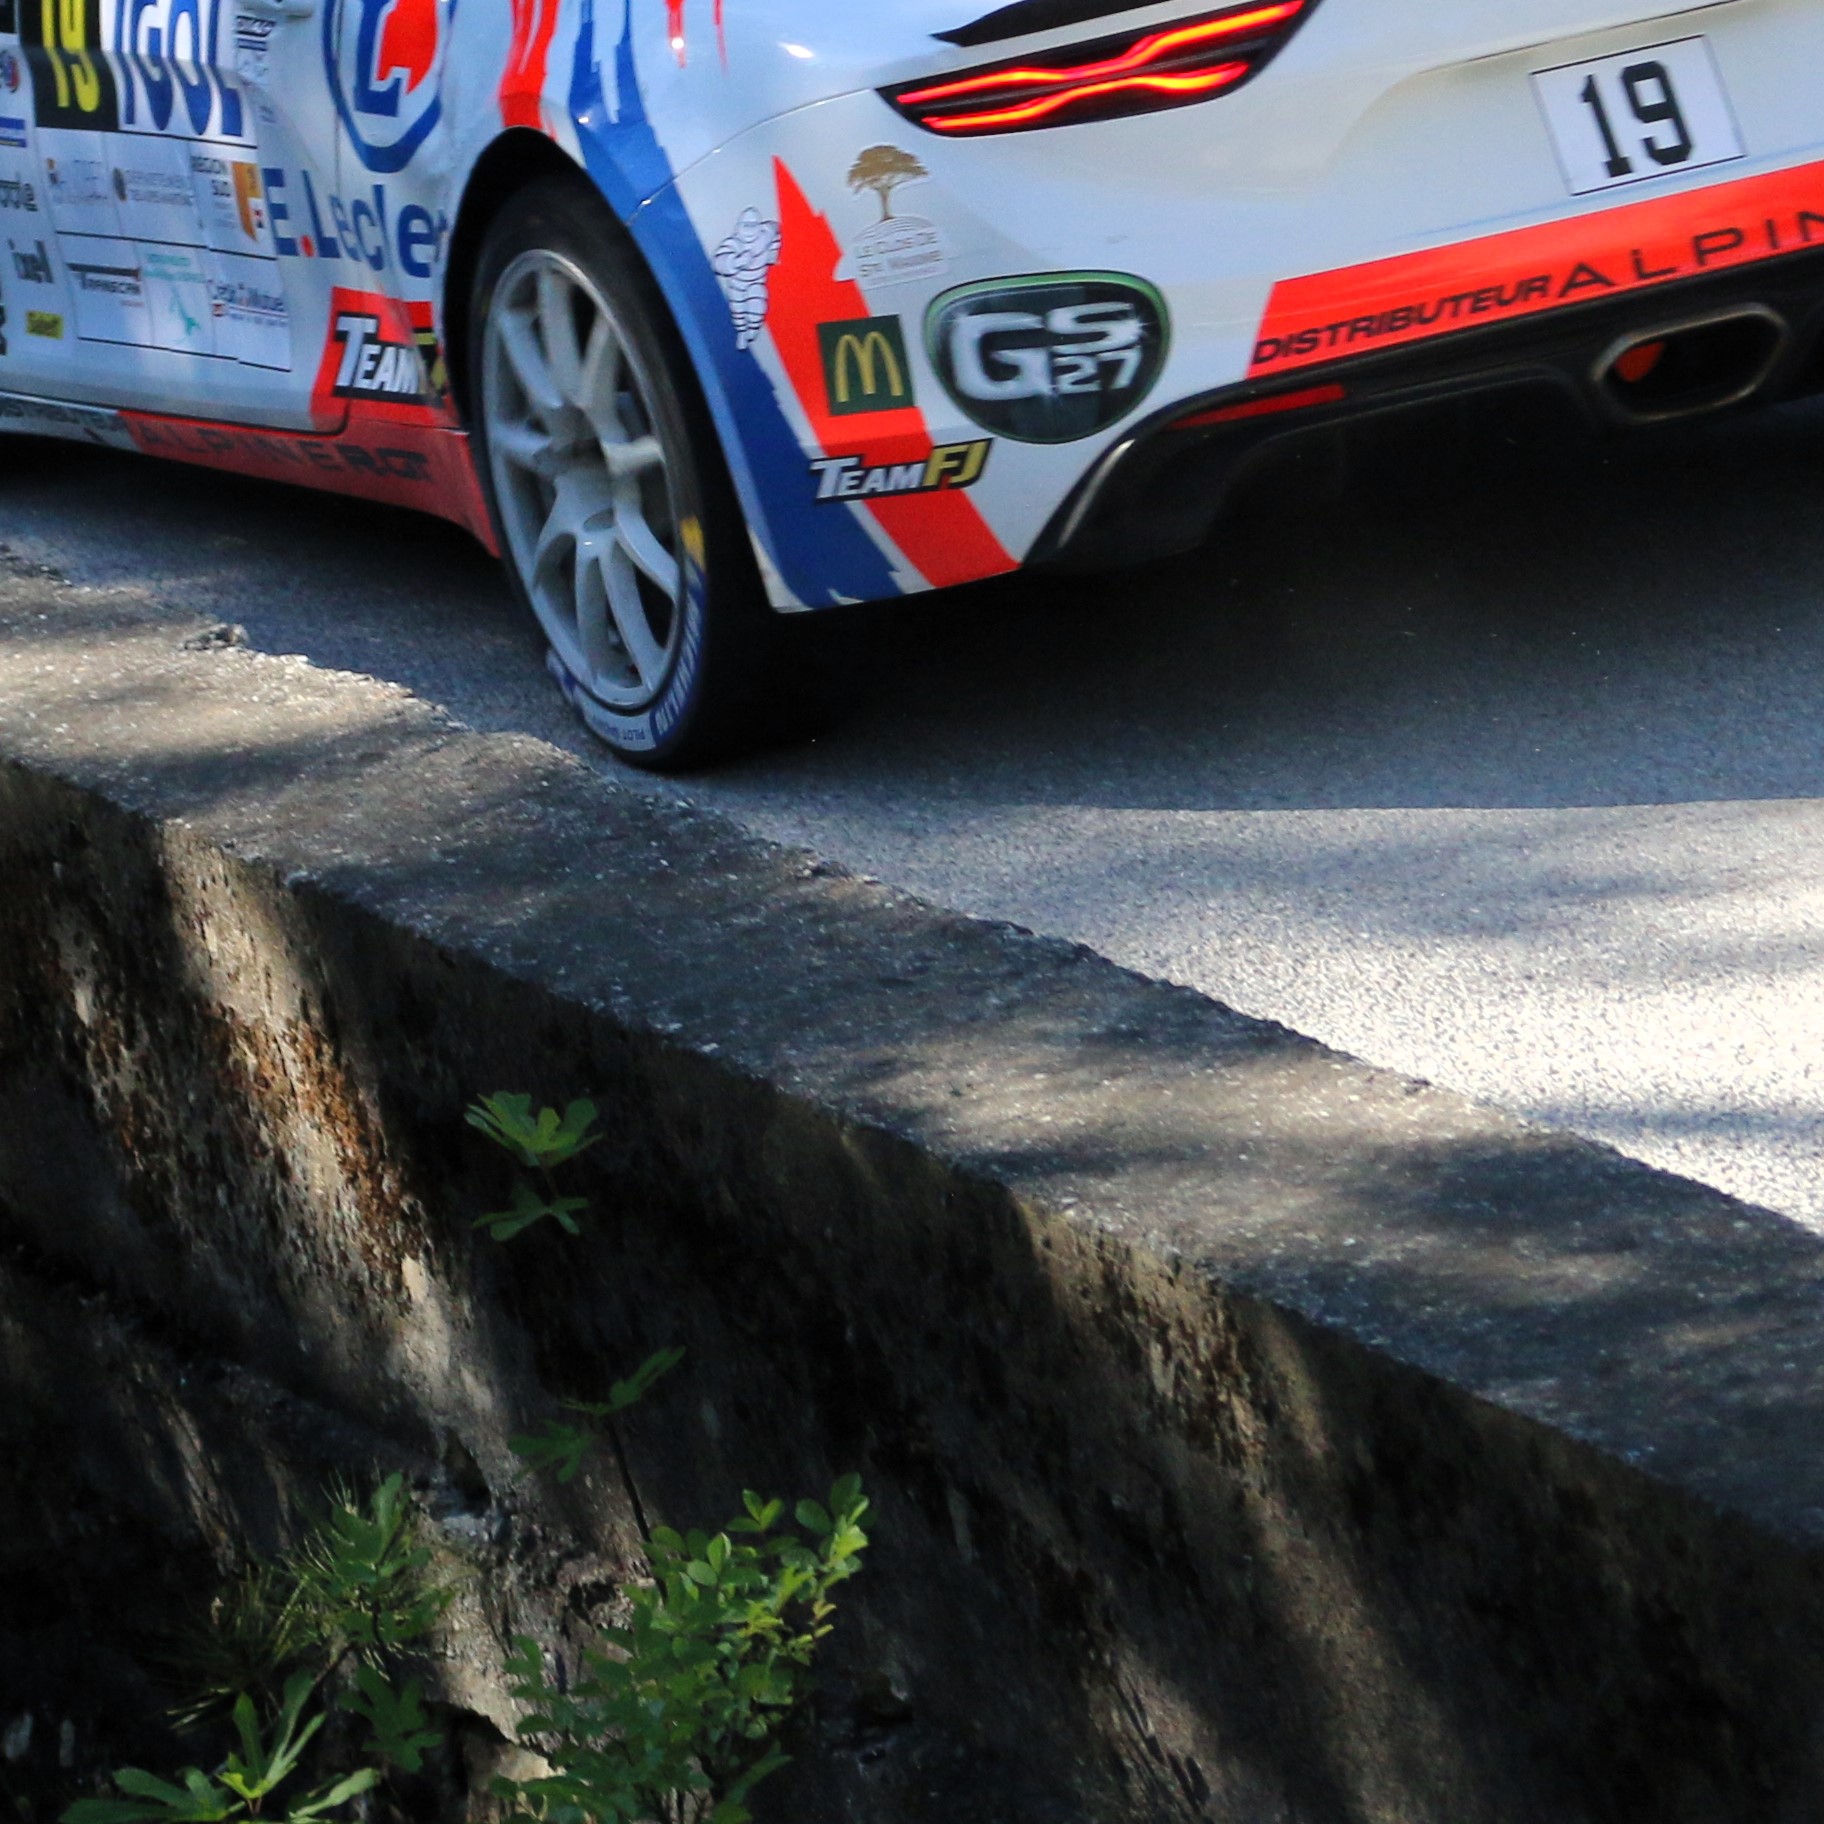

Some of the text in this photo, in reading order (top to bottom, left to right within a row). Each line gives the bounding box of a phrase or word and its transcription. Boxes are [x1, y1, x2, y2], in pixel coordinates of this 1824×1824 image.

[1581, 60, 1695, 178] 19
[1252, 275, 1552, 366] DISTRIBUTEUR
[812, 439, 991, 502] TEAMFJ
